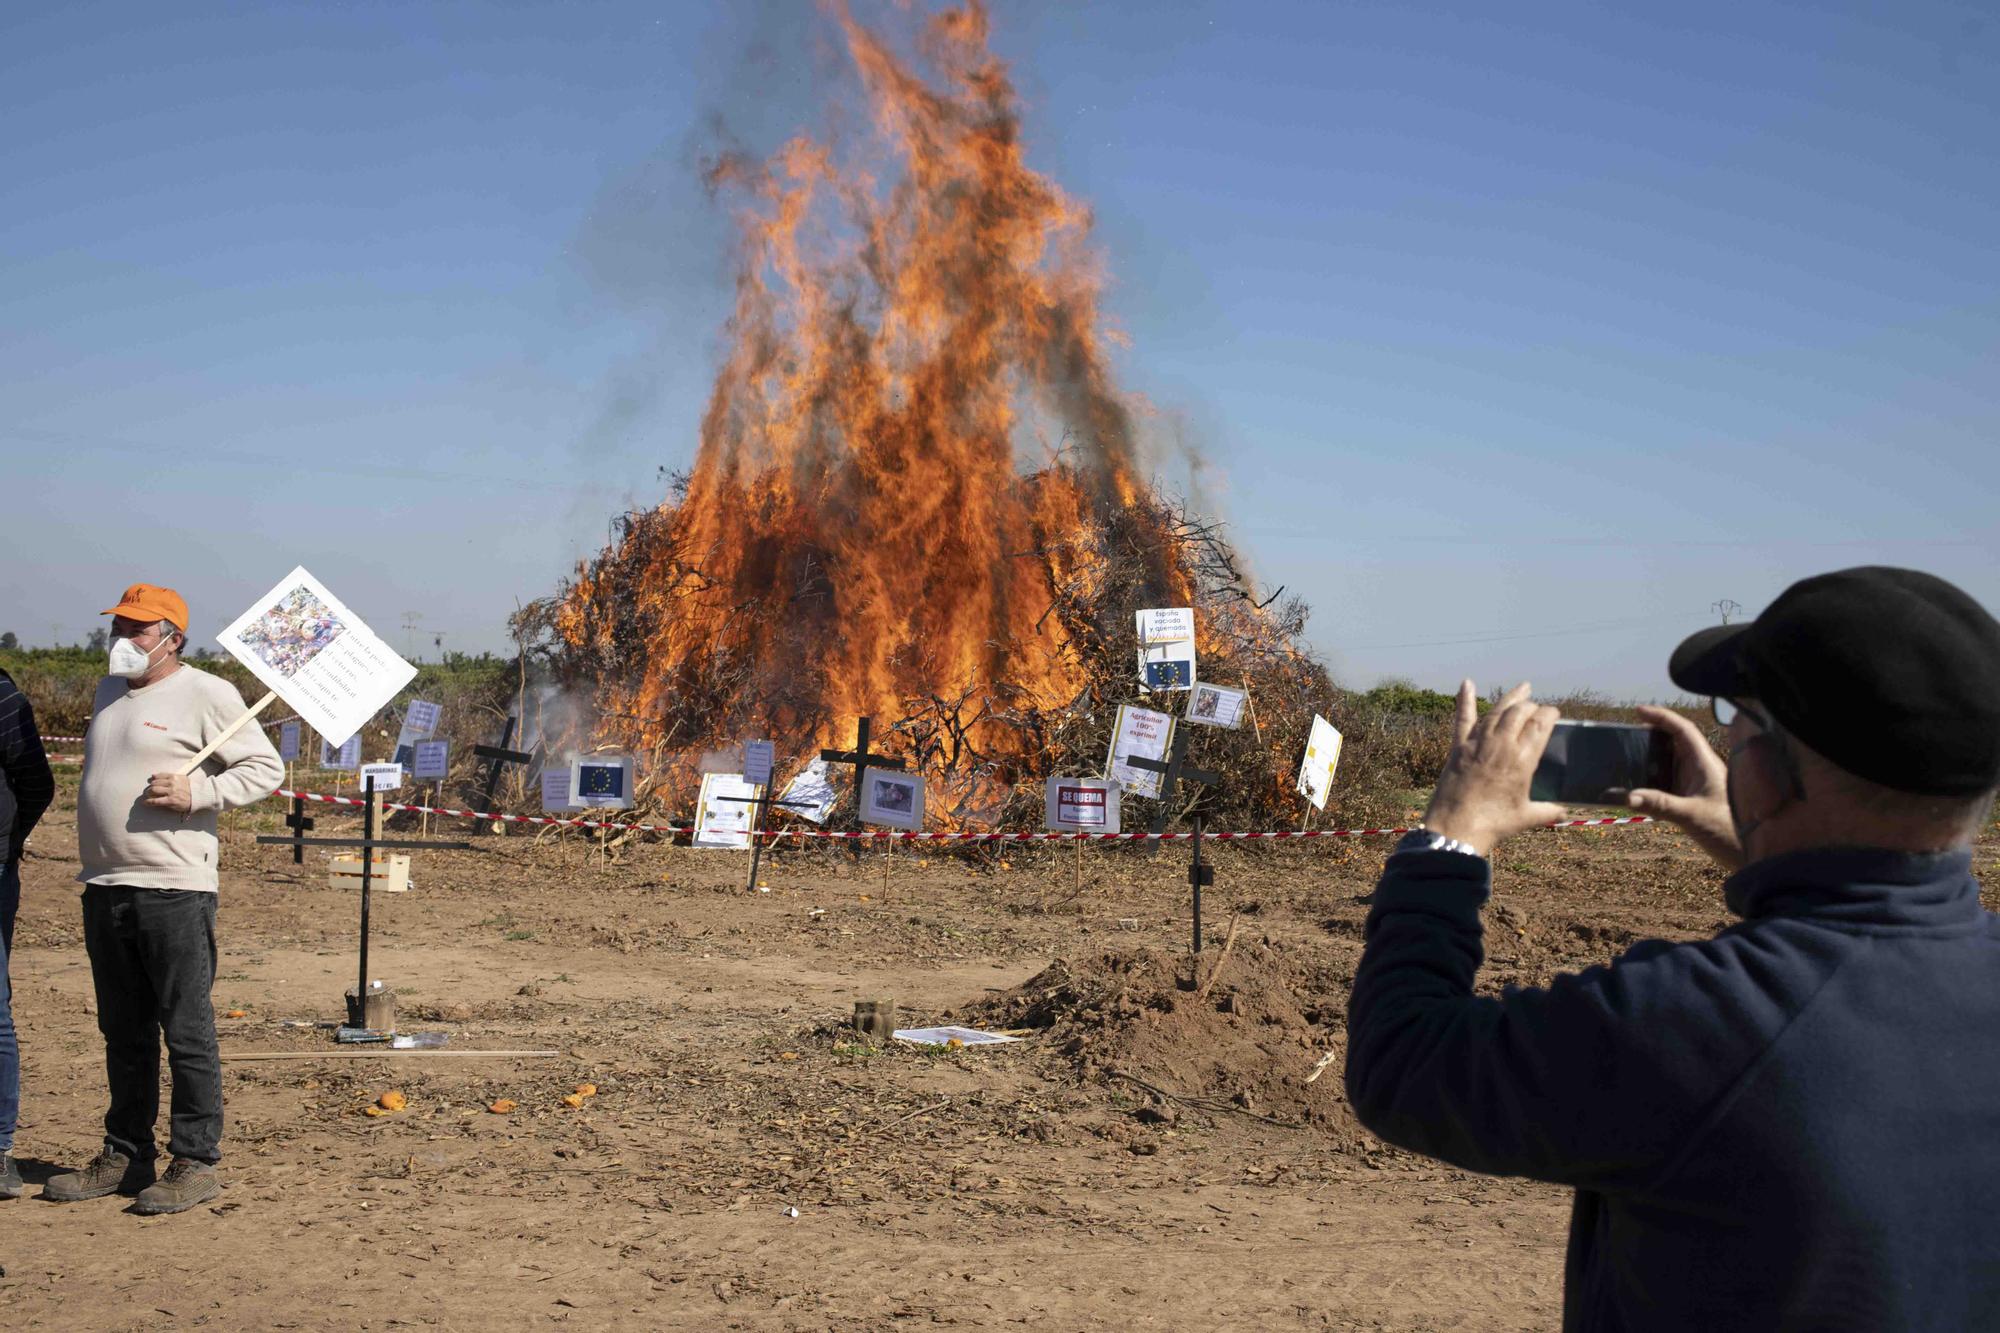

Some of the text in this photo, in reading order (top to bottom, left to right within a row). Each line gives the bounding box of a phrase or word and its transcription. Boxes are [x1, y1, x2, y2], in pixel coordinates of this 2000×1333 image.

[1130, 712, 1163, 724] Agricultor
[1136, 722, 1154, 731] 100%
[1130, 730, 1157, 740] exprimit
[1063, 792, 1102, 803] SE QUEMA
